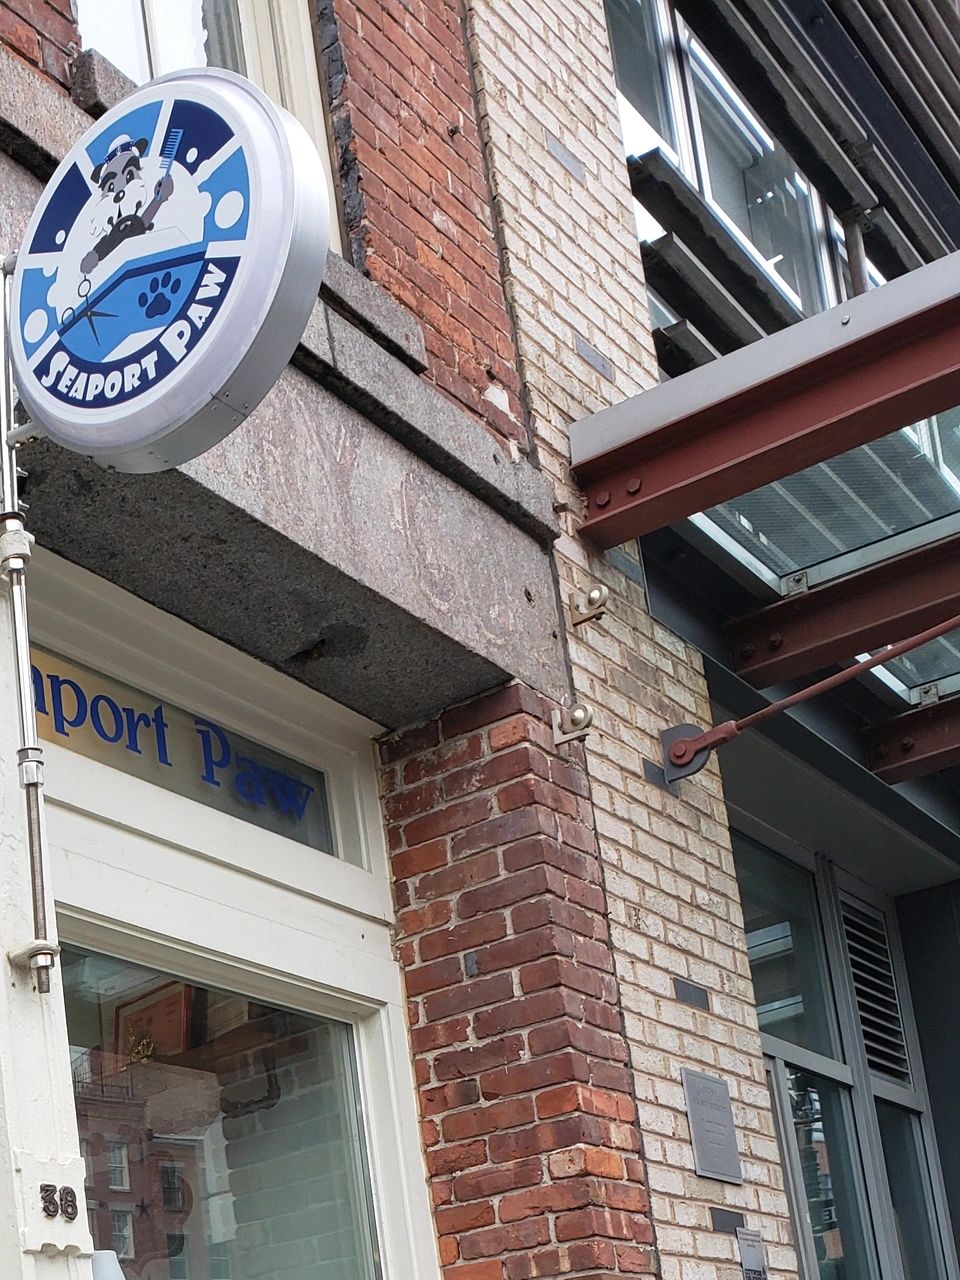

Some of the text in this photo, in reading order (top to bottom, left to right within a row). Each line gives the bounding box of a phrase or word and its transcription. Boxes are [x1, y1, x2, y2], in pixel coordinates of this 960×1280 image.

[41, 261, 228, 401] SEAPORT PAW
[194, 720, 315, 822] Paw
[40, 1184, 78, 1220] 38
